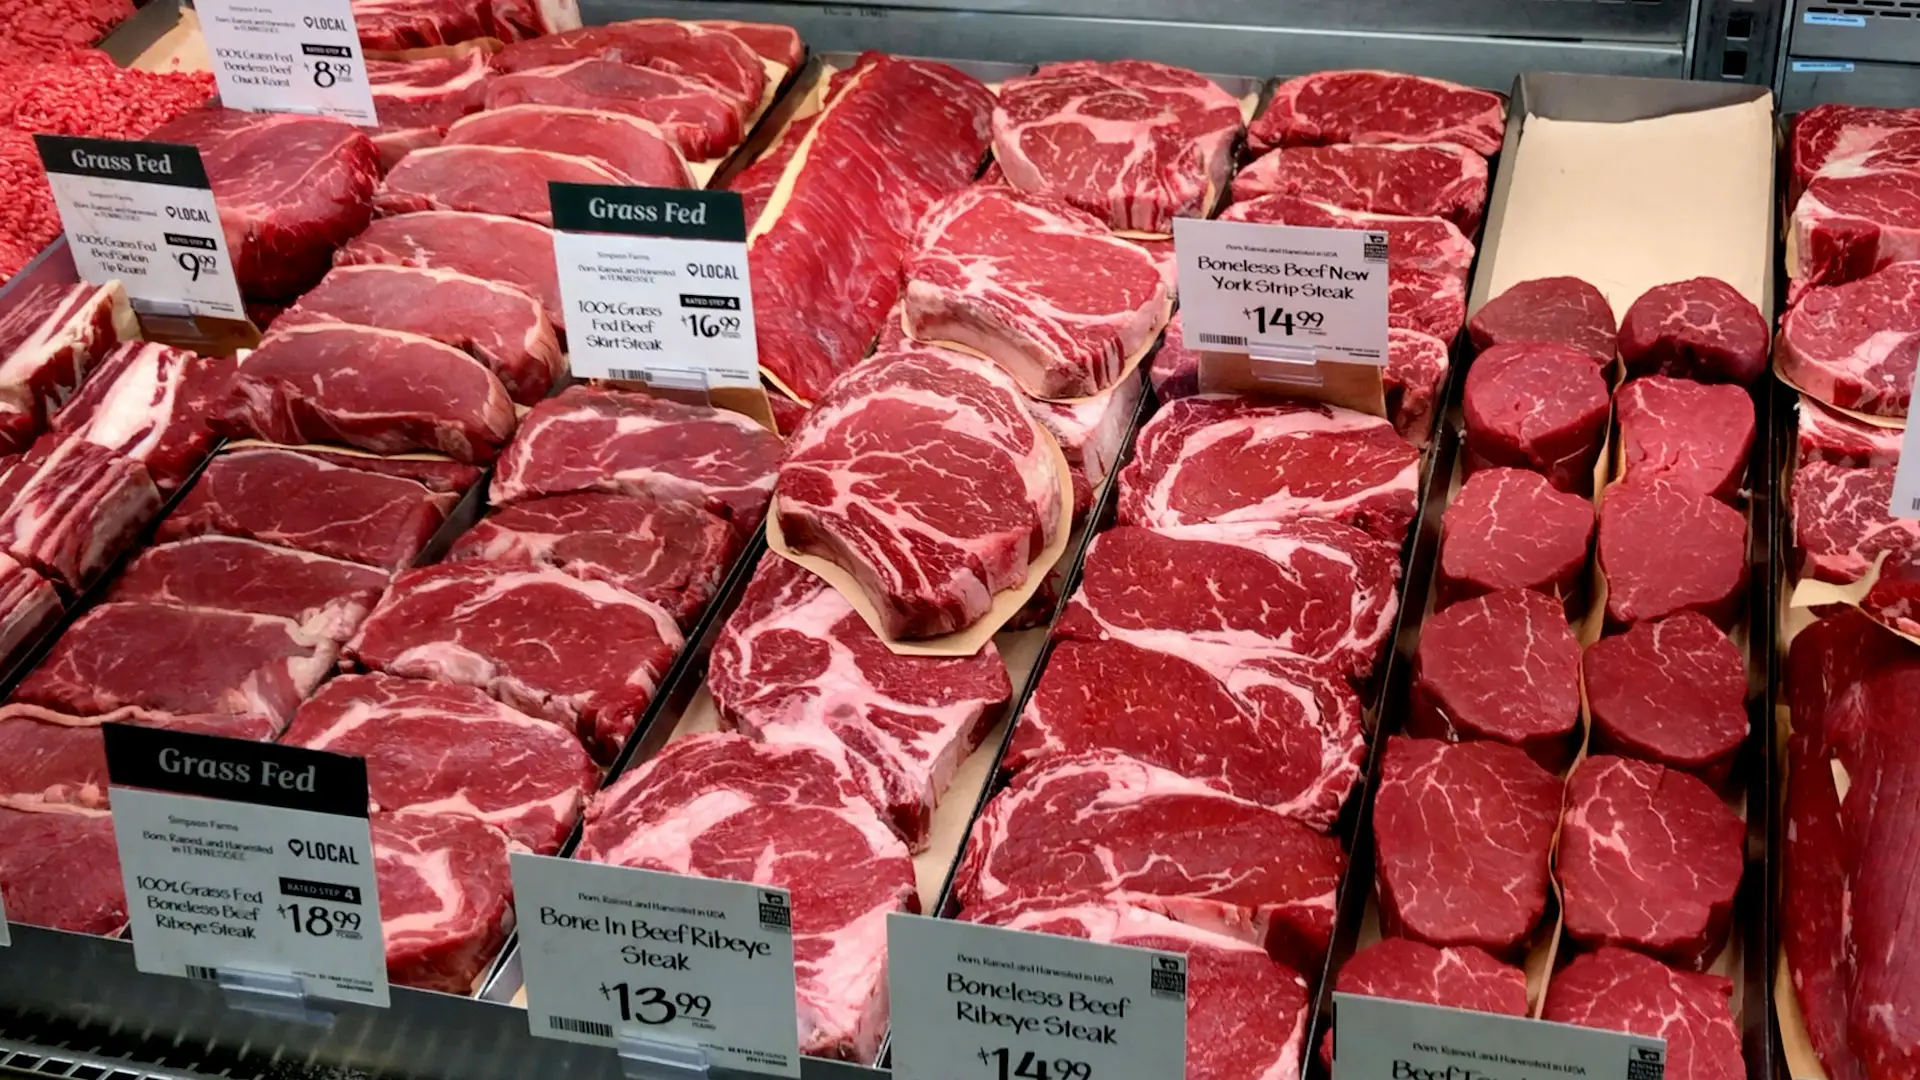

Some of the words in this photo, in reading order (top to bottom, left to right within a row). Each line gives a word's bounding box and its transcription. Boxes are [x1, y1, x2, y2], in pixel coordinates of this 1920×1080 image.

[315, 17, 348, 31] LOCAL
[341, 47, 349, 56] 4
[71, 149, 132, 171] Grass
[135, 154, 173, 174] Fed
[176, 208, 211, 223] LOCAL
[589, 197, 658, 221] Grass
[664, 201, 707, 225] Fed
[204, 238, 213, 248] 4
[700, 264, 739, 280] LOCAL
[1198, 256, 1281, 275] Boneless
[1284, 262, 1329, 278] Beef
[1330, 266, 1369, 281] New
[1212, 275, 1253, 291] York
[1256, 280, 1299, 297] Strip
[1303, 284, 1354, 300] Steak
[578, 300, 615, 314] 100%
[618, 303, 662, 316] Grass
[684, 297, 708, 306] RATED
[727, 298, 736, 308] 4
[592, 320, 619, 332] Fed
[621, 320, 655, 334] Beef
[586, 336, 619, 349] Skirt
[620, 336, 663, 351] Steak
[158, 747, 251, 783] Grass
[261, 759, 316, 793] Fed
[306, 841, 360, 866] LOCAL
[137, 875, 179, 893] 100%
[181, 881, 231, 900] Grass
[233, 887, 263, 904] Fed
[287, 883, 317, 895] RATED
[319, 887, 341, 897] STEP
[344, 888, 355, 901] 4
[147, 895, 220, 917] Boneless
[222, 905, 260, 921] Beef
[156, 914, 209, 936] Ribeye
[209, 921, 257, 940] Steak
[540, 906, 600, 932] Bone
[606, 915, 626, 936] In
[632, 920, 692, 944] Beef
[692, 928, 772, 959] Ribeye
[621, 945, 691, 971] Steak
[947, 972, 1063, 1008] Boneless
[1069, 991, 1131, 1019] Beef
[957, 1001, 1040, 1035] Ribeye
[1043, 1016, 1118, 1045] Steak
[1392, 1059, 1460, 1080] Beef
